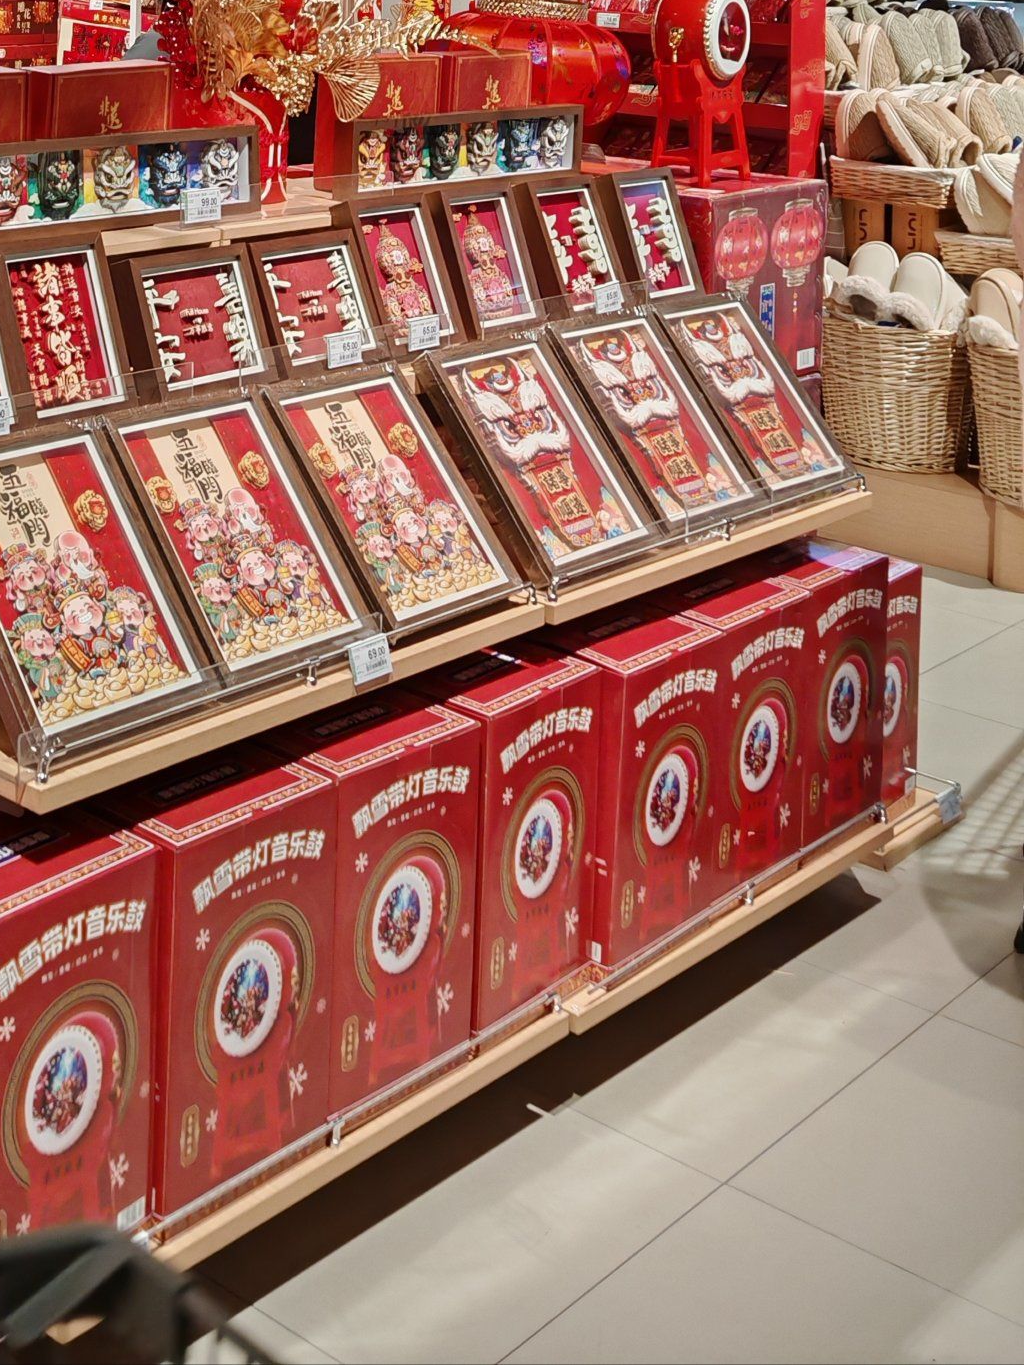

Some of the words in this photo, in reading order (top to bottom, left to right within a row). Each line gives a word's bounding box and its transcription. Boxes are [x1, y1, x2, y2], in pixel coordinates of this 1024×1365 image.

[200, 197, 216, 207] 99.00
[421, 325, 435, 336] 65.00
[342, 341, 357, 352] 65.00
[365, 645, 386, 660] 69.00
[350, 765, 471, 840] 飘雪带灯音乐鼓
[191, 828, 326, 915] 飘雪带灯音乐鼓
